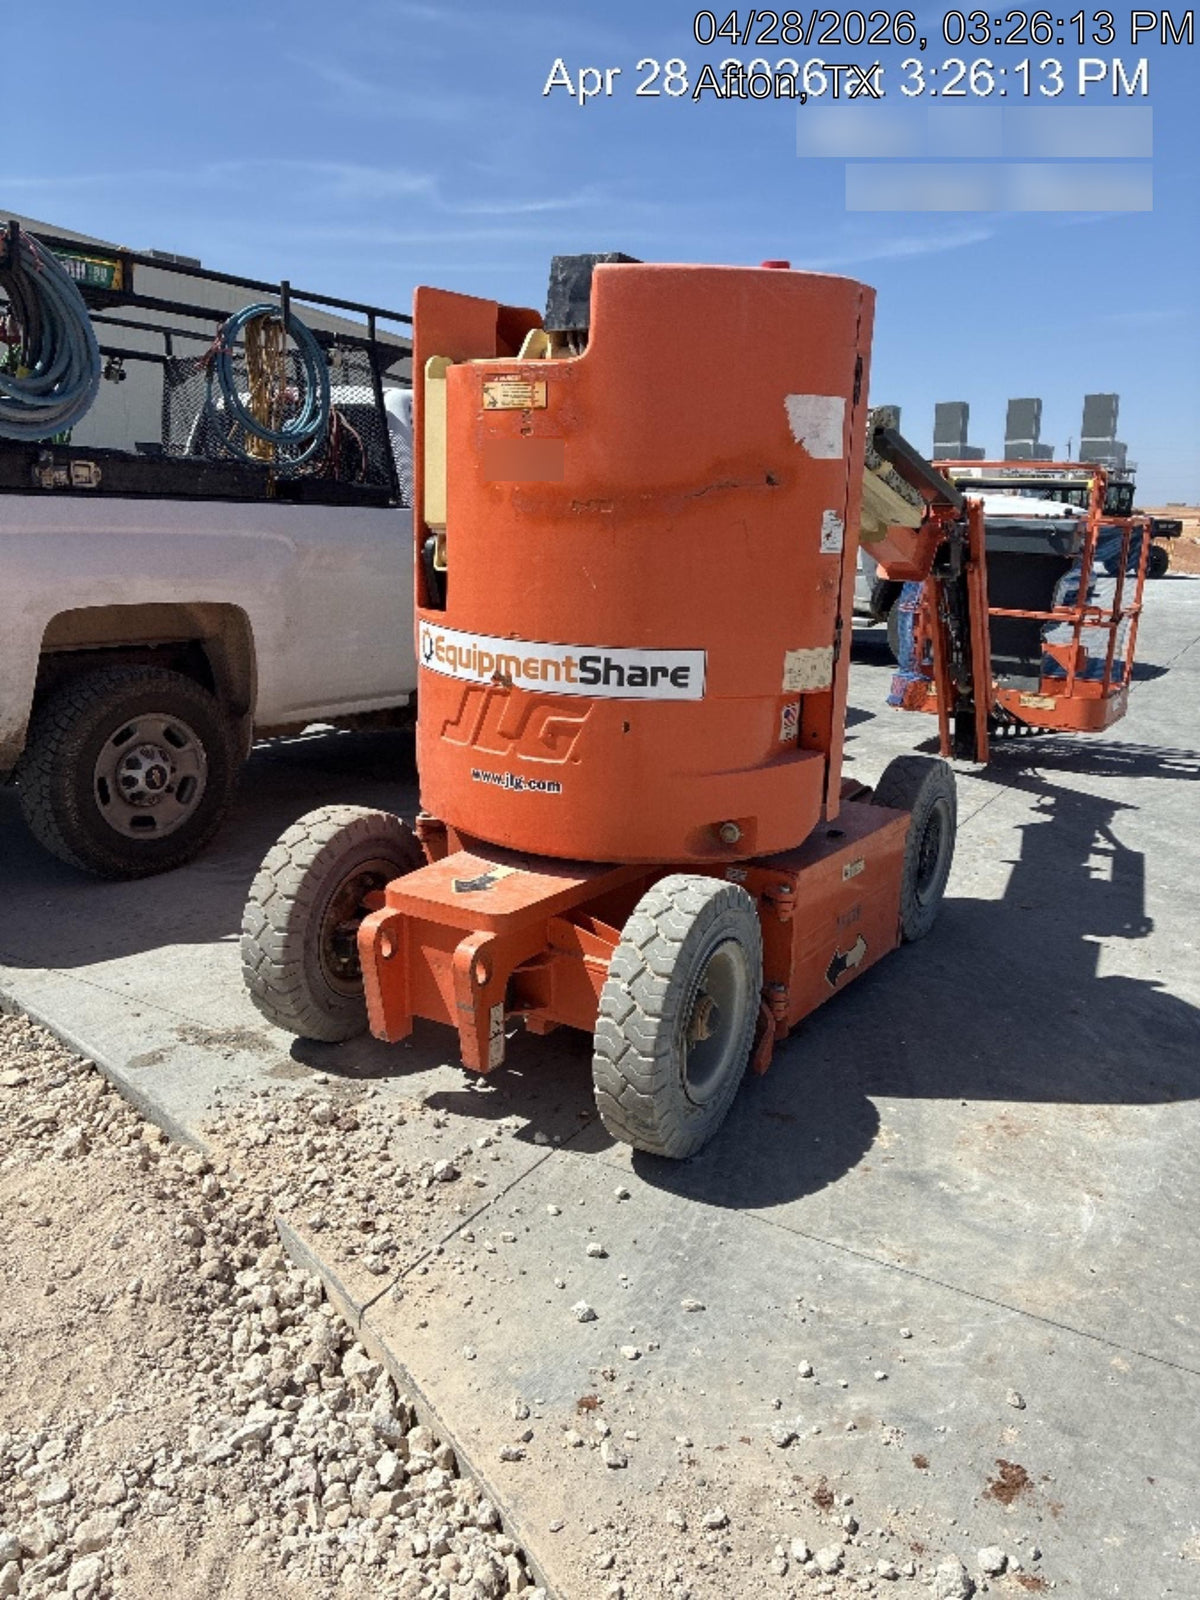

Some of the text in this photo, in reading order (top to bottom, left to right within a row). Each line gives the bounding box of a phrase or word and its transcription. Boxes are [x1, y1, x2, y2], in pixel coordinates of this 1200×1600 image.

[435, 635, 691, 689] EquipmentShare
[441, 686, 593, 764] JLG
[471, 768, 562, 794] www.jlg.com
